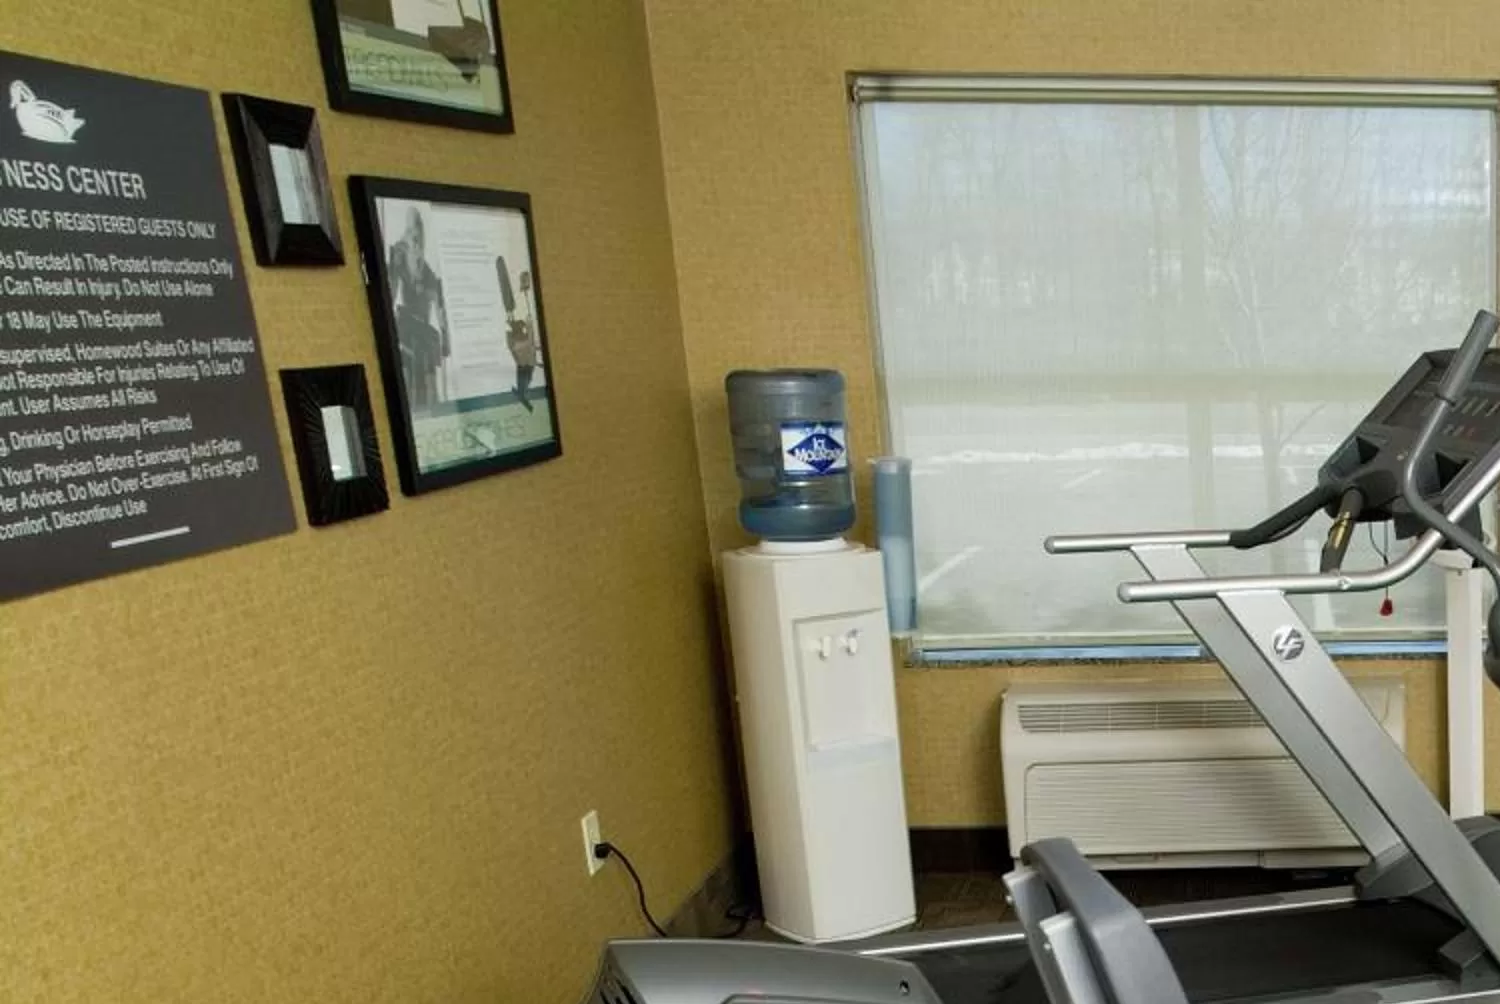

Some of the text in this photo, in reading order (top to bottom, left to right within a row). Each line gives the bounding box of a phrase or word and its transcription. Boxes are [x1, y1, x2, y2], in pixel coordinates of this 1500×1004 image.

[0, 158, 147, 199] NESS CENTER
[31, 209, 51, 229] OF
[53, 211, 137, 235] REGISTERED
[138, 217, 186, 237] GUESTS
[186, 220, 216, 239] ONLY
[15, 250, 71, 271] Directed
[71, 252, 85, 272] In
[83, 253, 109, 272] The
[108, 253, 150, 273] Posted
[4, 276, 34, 296] Can
[32, 276, 75, 297] Result
[74, 278, 88, 297] In
[121, 278, 140, 297] Do
[139, 279, 161, 297] Not
[160, 280, 184, 297] Use
[6, 311, 21, 330] 18
[21, 310, 51, 334] May
[51, 311, 79, 329] Use
[77, 310, 103, 329] The
[75, 342, 142, 361] Homewood
[142, 340, 177, 358] Suites
[176, 339, 191, 357] Or
[191, 338, 211, 359] Any
[16, 368, 95, 392] Responsible
[95, 366, 115, 384] For
[115, 364, 156, 387] Injuries
[156, 362, 199, 381] Relating
[198, 359, 212, 376] To
[211, 359, 232, 375] Use
[231, 357, 245, 375] Of
[18, 396, 51, 416] User
[52, 393, 111, 413] Assumes
[111, 388, 126, 407] All
[9, 428, 64, 450] Drinking
[63, 425, 80, 444] Or
[81, 419, 141, 443] Horseplay
[2, 466, 33, 487] Your
[33, 459, 95, 484] Physician
[94, 453, 135, 473] Before
[134, 444, 190, 468] Exercising
[190, 440, 212, 459] And
[66, 484, 87, 501] Do
[87, 480, 111, 498] Not
[201, 461, 225, 479] First
[224, 459, 247, 478] Sign
[245, 455, 259, 472] Of
[51, 504, 123, 530] Discontinue
